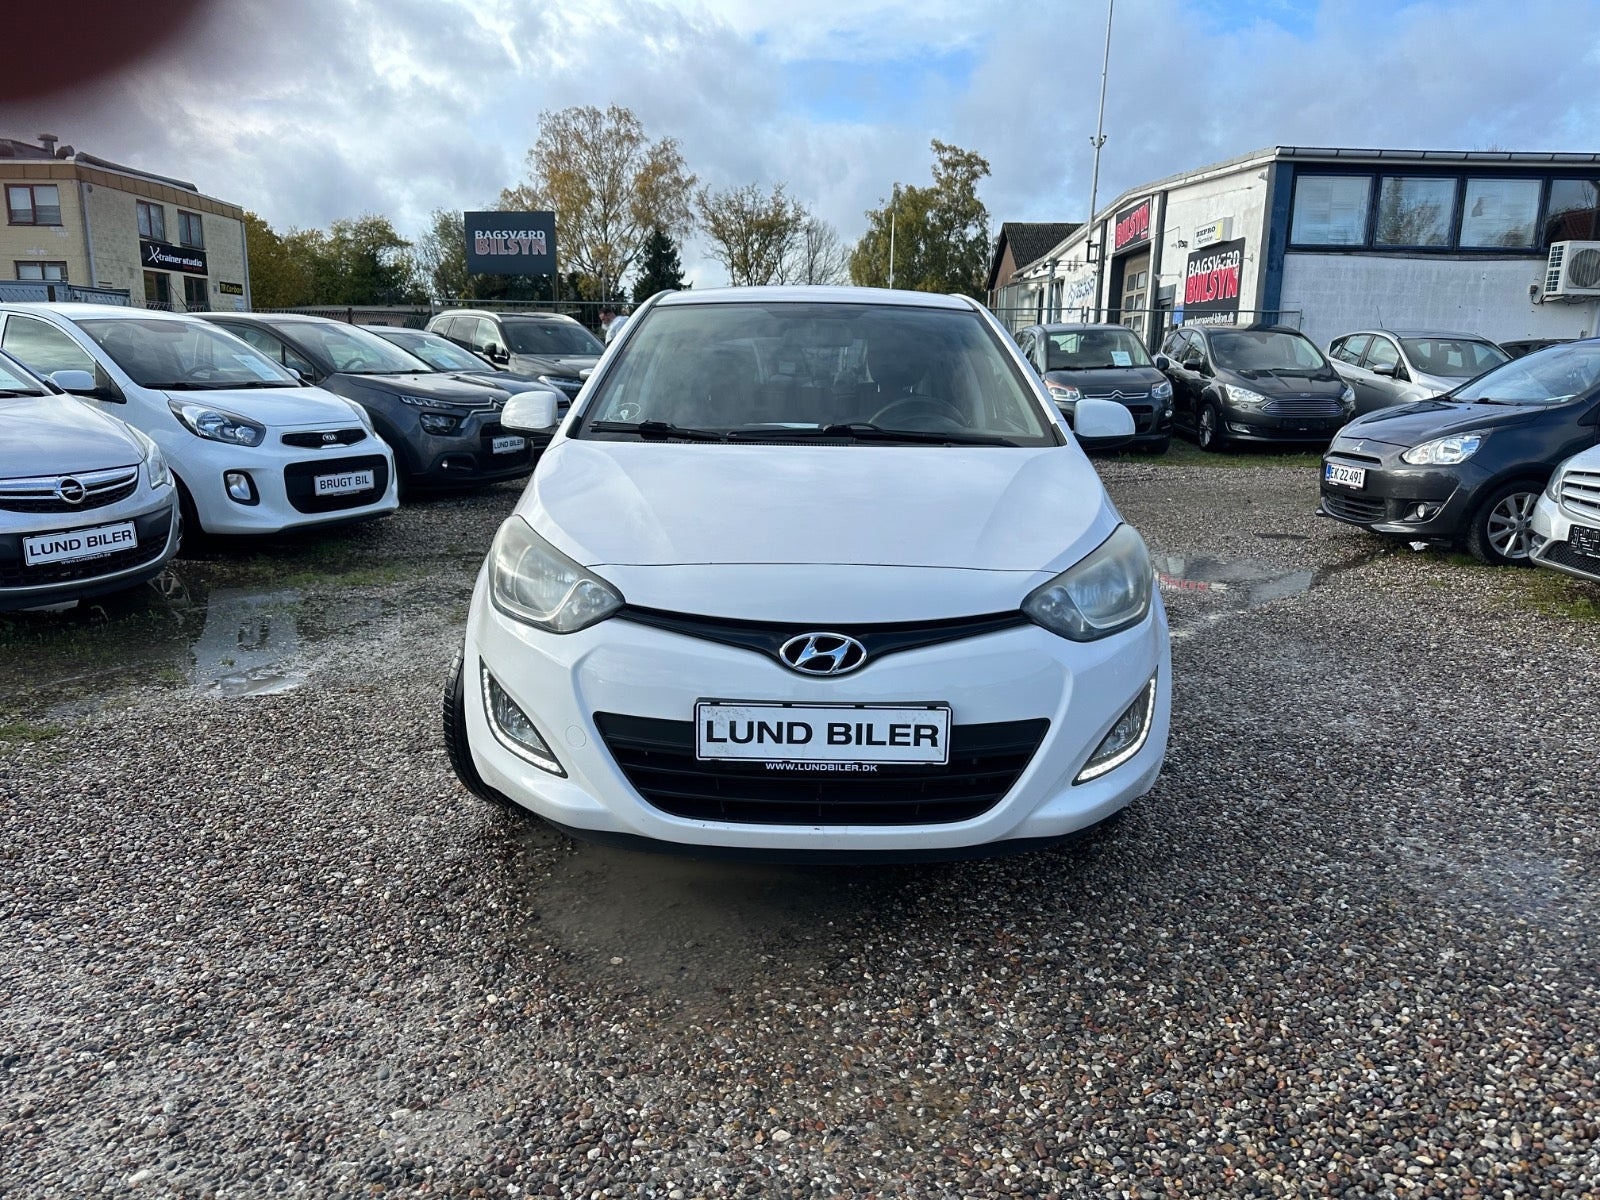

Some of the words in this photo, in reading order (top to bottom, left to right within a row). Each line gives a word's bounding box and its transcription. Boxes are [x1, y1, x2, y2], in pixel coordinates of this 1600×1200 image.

[1115, 202, 1149, 249] BILSYN
[475, 230, 546, 240] BAGSVÆRD
[475, 237, 547, 255] BILSYN
[182, 257, 203, 267] studio
[1185, 266, 1240, 304] BILSYN
[494, 441, 508, 449] LUND
[320, 477, 352, 489] BRUGT
[355, 475, 369, 485] BIL
[1340, 469, 1349, 481] 22
[1350, 471, 1362, 484] 491
[29, 538, 81, 556] LUND
[87, 529, 132, 548] BILER
[706, 720, 813, 745] LUND
[827, 722, 939, 747] BILER
[765, 762, 878, 772] WWW.LUNDBILER.DK
